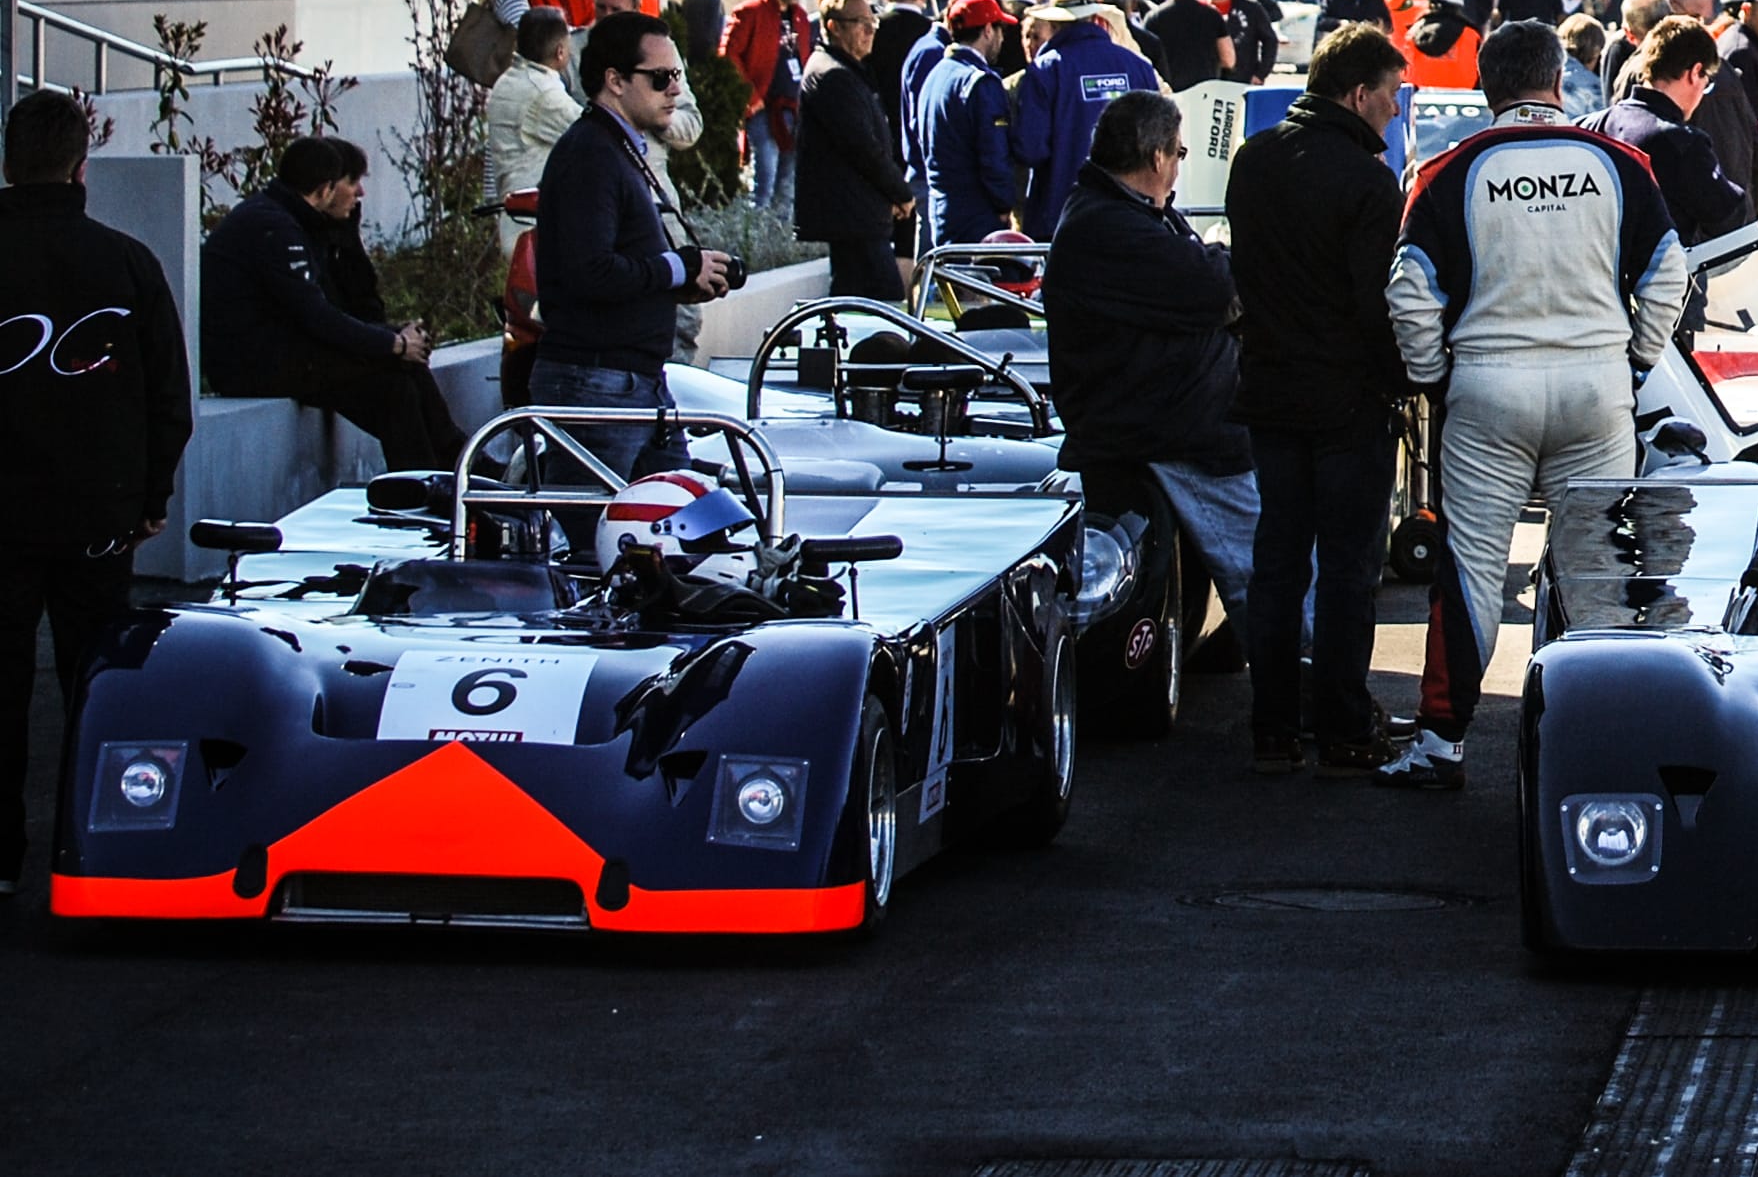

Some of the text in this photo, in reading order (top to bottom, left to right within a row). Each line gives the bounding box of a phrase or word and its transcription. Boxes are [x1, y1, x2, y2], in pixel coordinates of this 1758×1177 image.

[1095, 77, 1126, 87] FORD
[1207, 98, 1223, 158] ELFORD
[1219, 101, 1236, 162] LARROUSSE
[1486, 172, 1601, 203] MONZA
[1527, 203, 1567, 213] CAPITAL
[1129, 625, 1154, 659] STP
[435, 655, 561, 665] ZENITH
[451, 667, 528, 716] 6
